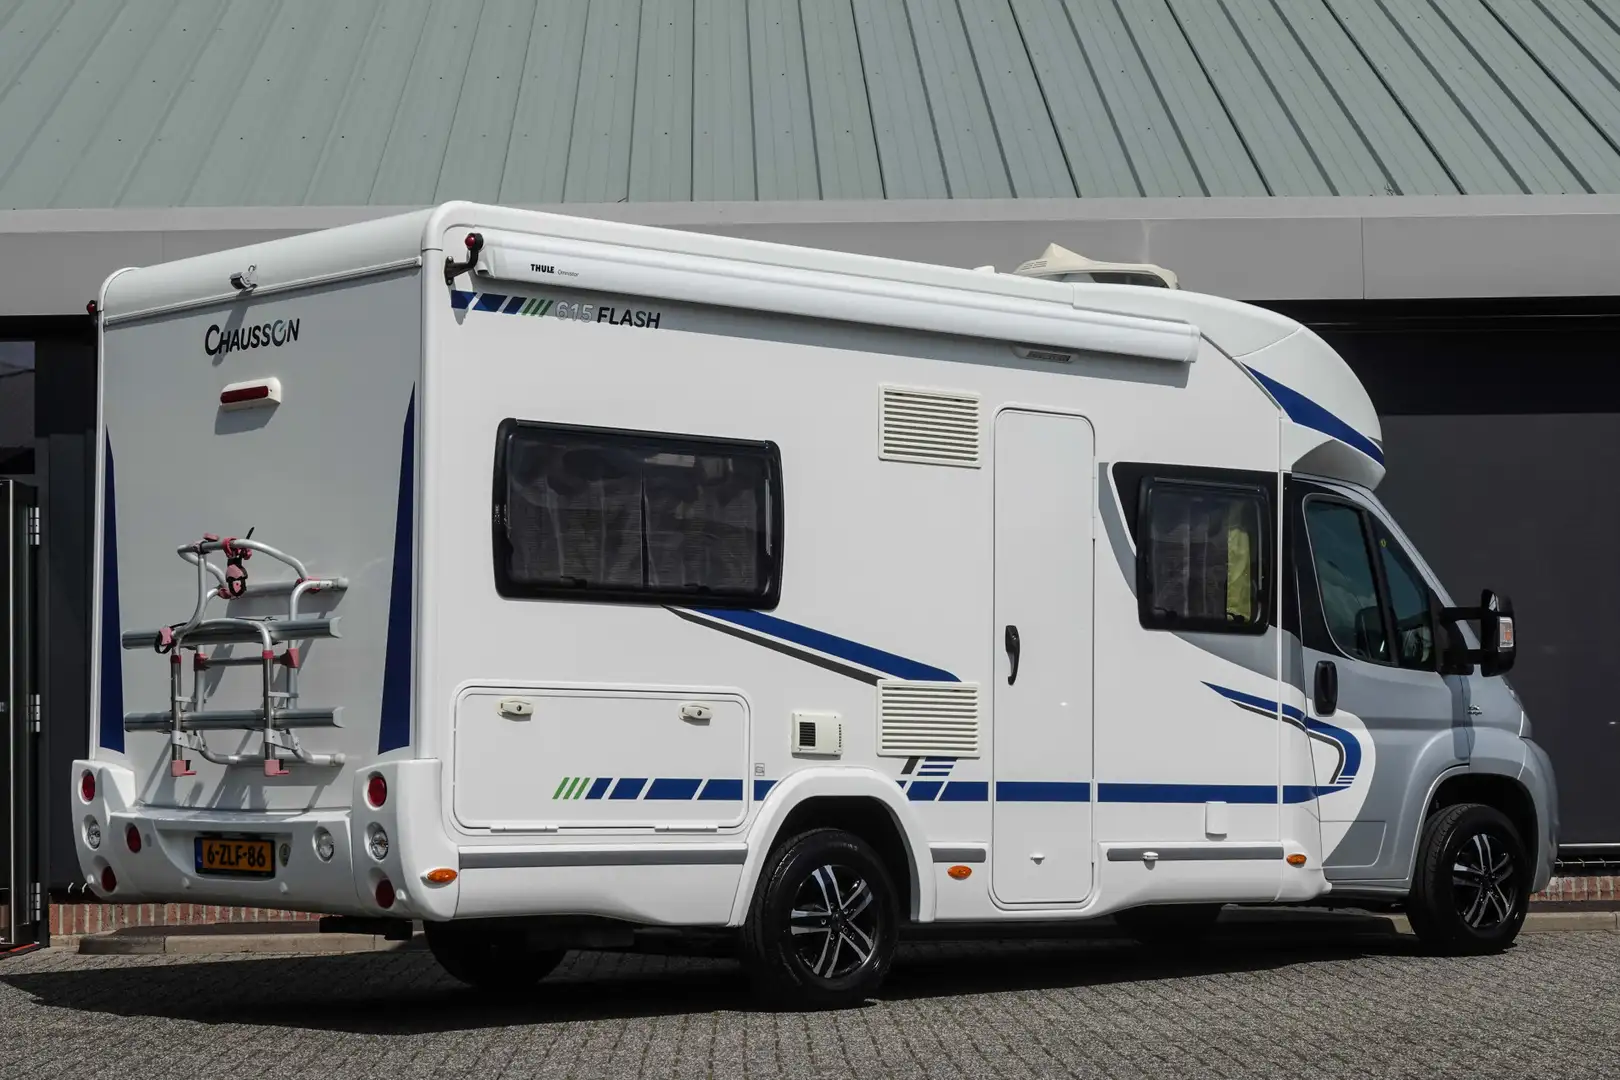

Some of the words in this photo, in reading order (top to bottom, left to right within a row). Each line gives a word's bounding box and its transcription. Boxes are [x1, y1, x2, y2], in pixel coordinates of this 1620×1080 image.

[530, 263, 555, 274] THULE
[555, 301, 594, 323] 615
[596, 306, 661, 329] FLASH
[204, 318, 300, 356] CHAUSSON
[206, 843, 266, 868] 6-ZLF-86
